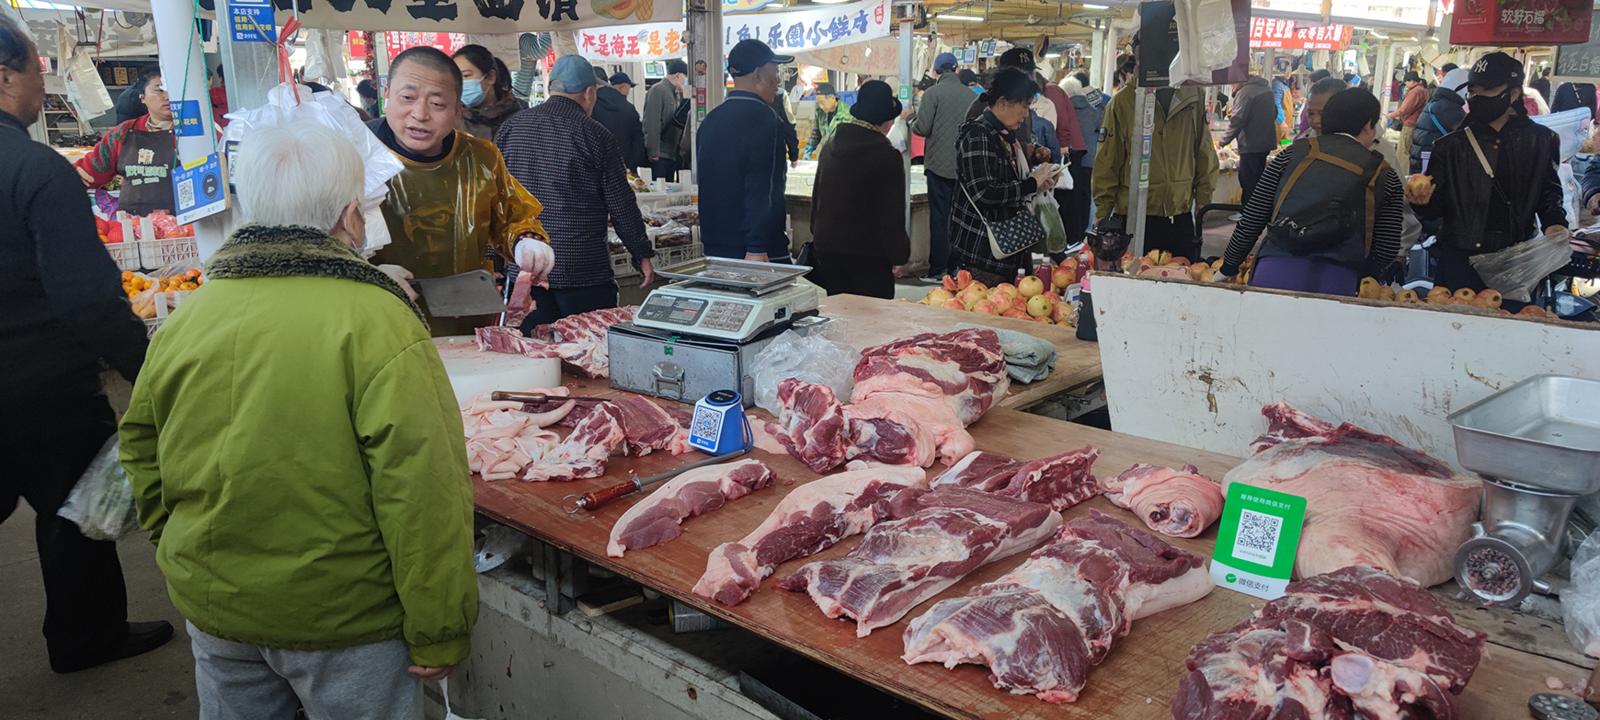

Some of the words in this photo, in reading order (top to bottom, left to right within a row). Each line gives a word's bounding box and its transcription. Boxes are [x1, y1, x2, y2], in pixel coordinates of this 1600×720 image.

[233, 8, 260, 16] 本店支持
[1501, 8, 1545, 25] 软籽石榴
[582, 33, 640, 57] 不是海王
[647, 28, 687, 56] 是老
[1474, 59, 1489, 73] NY
[1239, 578, 1269, 591] 微信支付
